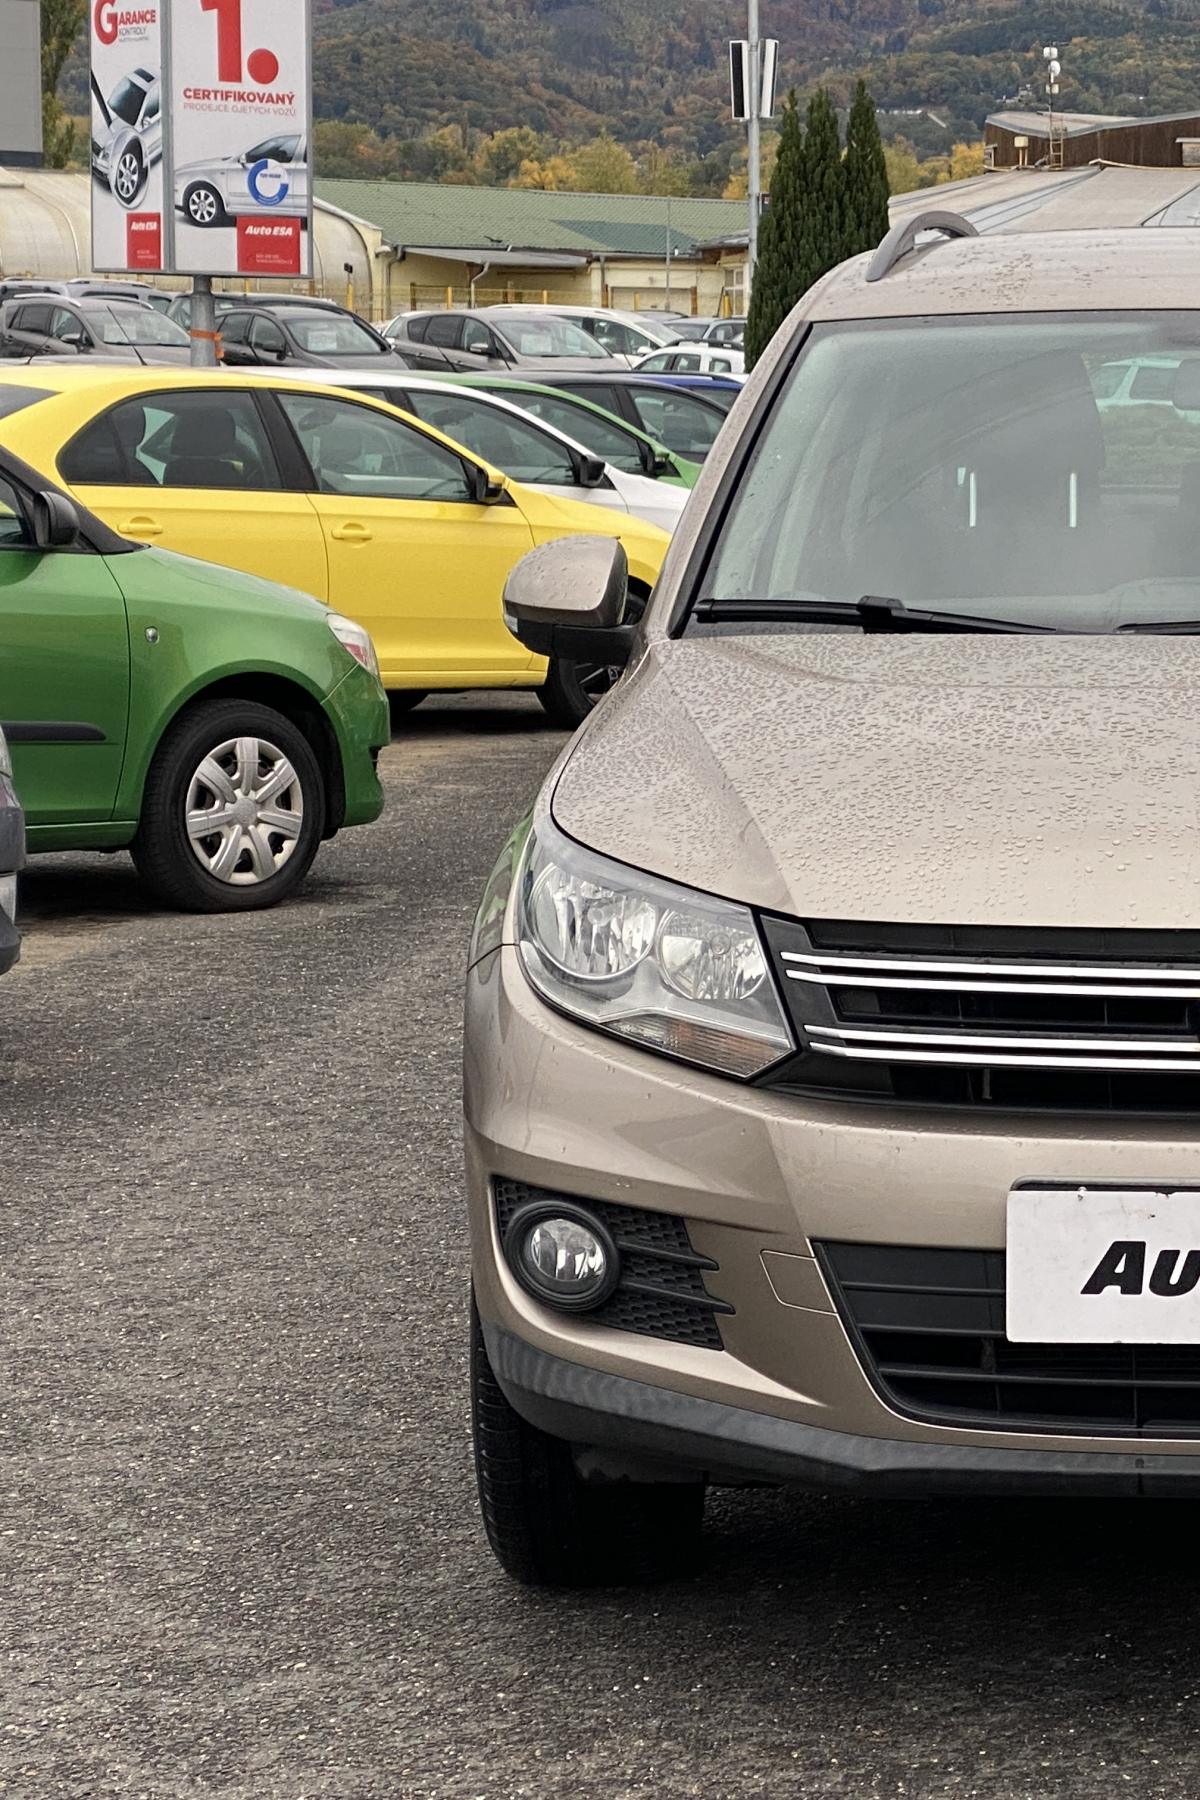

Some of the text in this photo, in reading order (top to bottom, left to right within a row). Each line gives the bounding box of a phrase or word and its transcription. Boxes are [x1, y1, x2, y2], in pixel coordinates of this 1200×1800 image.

[95, 0, 156, 45] GARANCE
[183, 88, 295, 105] CERTIFIKOVANÝ
[183, 102, 230, 113] PRODEJCE
[245, 225, 293, 236] Auto ESA
